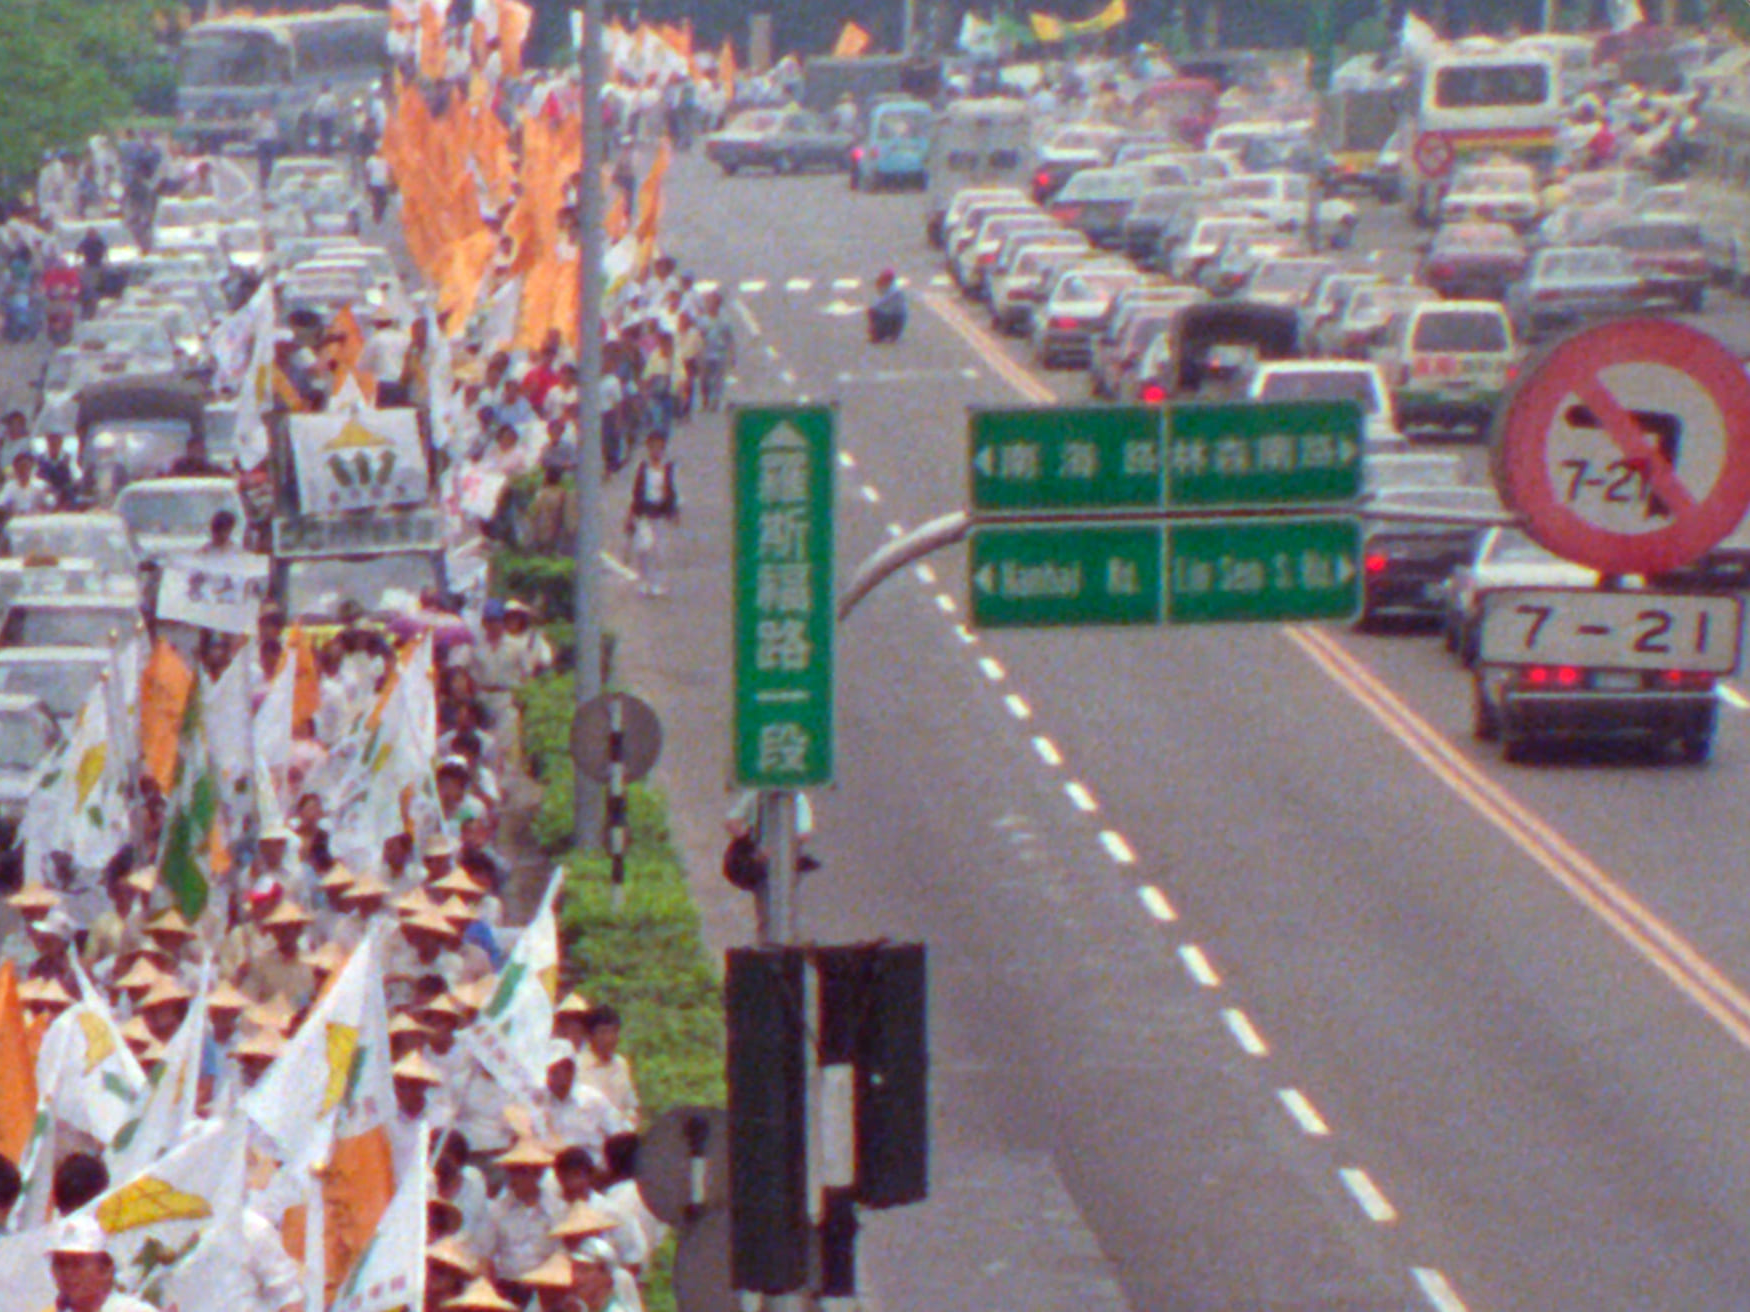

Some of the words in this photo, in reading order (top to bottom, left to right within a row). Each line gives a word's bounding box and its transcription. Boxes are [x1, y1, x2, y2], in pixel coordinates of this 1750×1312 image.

[1560, 457, 1652, 503] 7-21
[757, 450, 812, 775] 羅斯福路一段
[1515, 604, 1710, 655] 7-21
